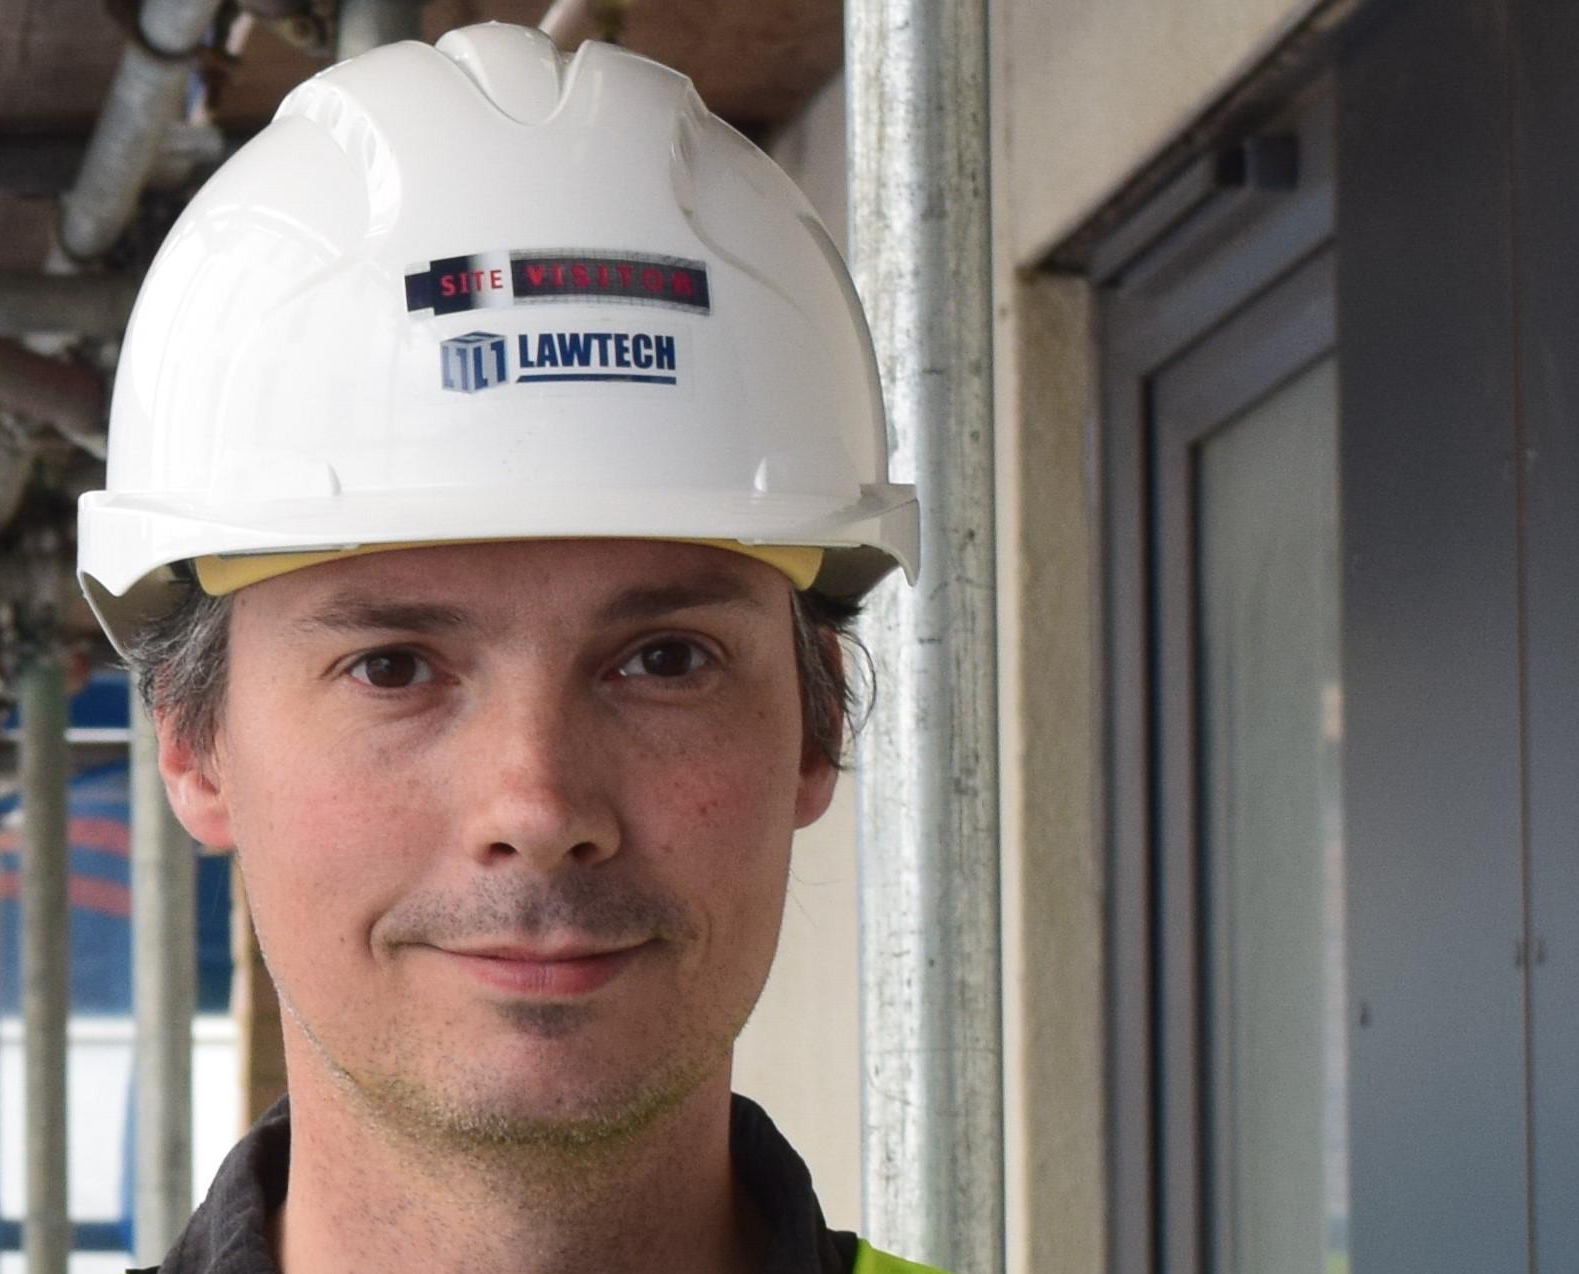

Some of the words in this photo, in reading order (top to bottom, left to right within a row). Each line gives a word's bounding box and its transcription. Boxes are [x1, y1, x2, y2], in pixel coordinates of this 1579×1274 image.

[440, 269, 504, 297] SITE
[524, 263, 694, 296] VISITOR
[518, 332, 677, 371] LAWTECH
